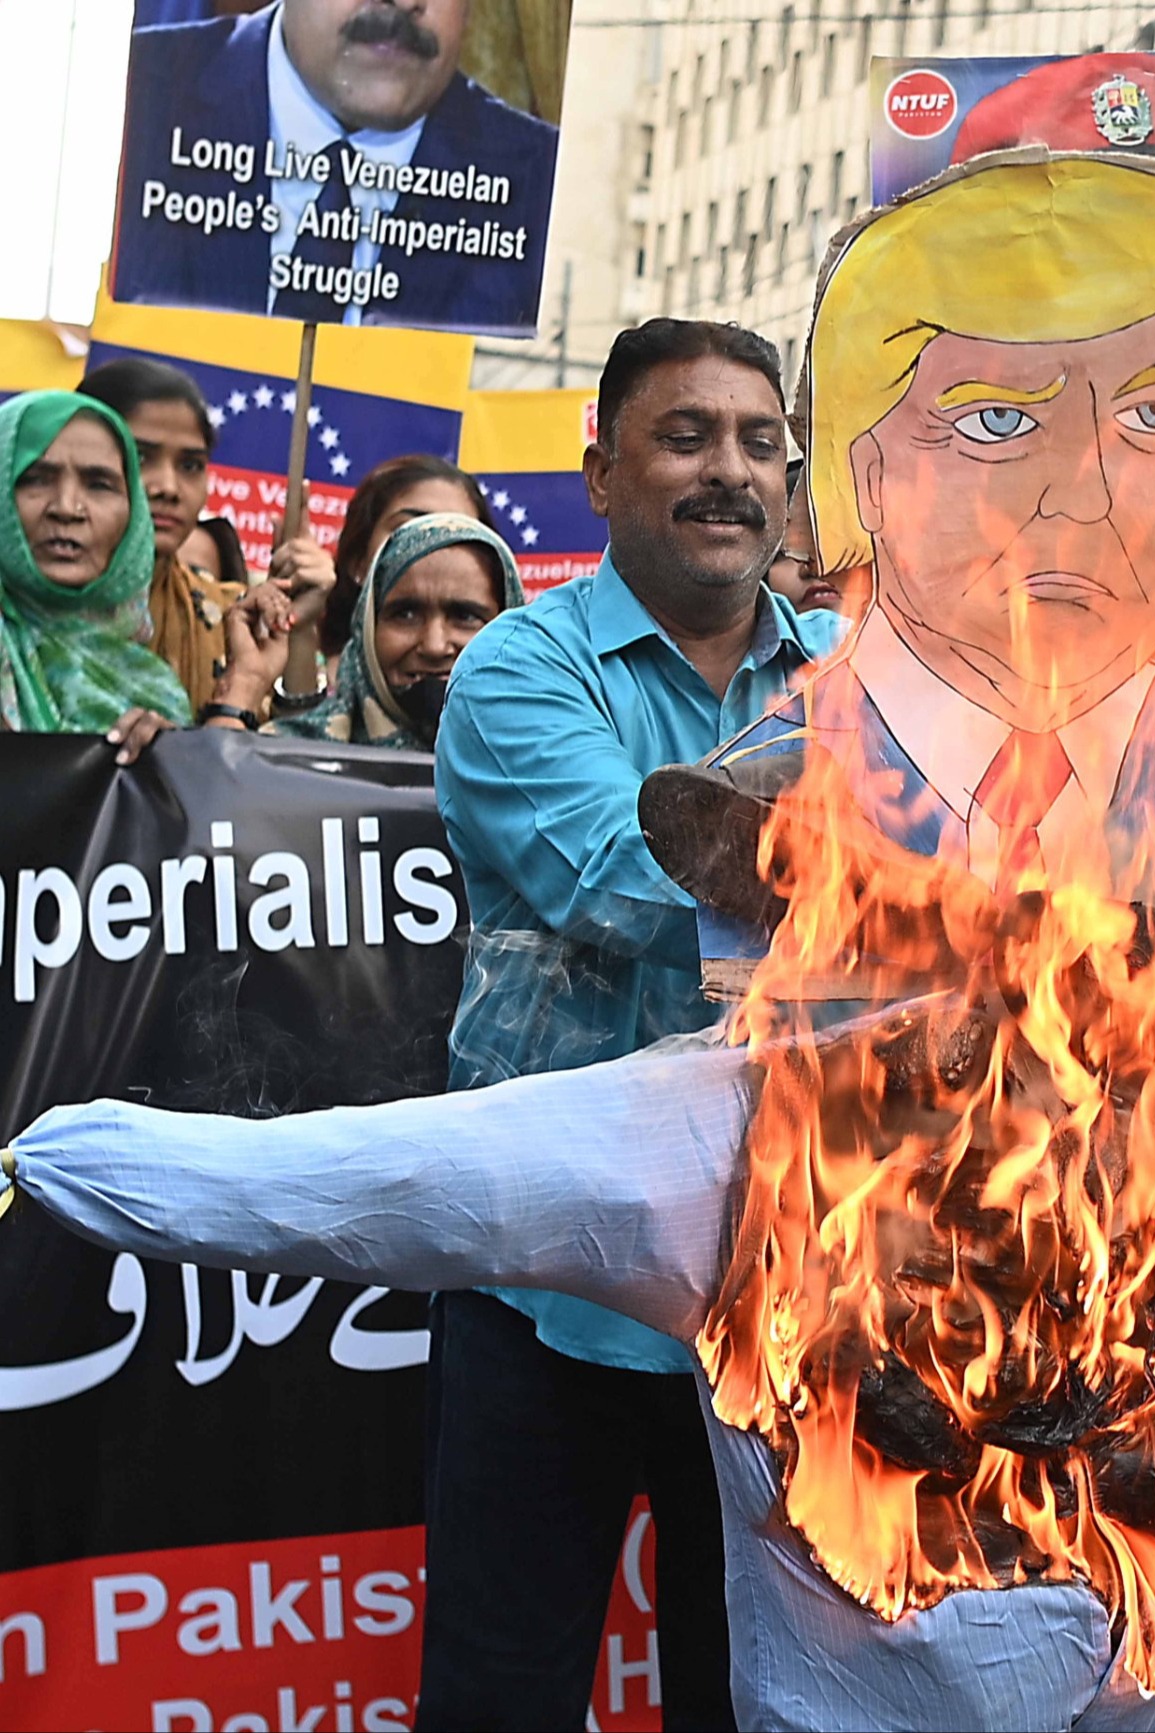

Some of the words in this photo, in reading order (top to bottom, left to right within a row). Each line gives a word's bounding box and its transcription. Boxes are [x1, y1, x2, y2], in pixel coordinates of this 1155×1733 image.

[891, 93, 950, 111] NTUF
[171, 127, 254, 183] Long
[264, 140, 330, 183] Live
[340, 149, 510, 204] Venezuelan
[141, 180, 280, 234] People's
[297, 203, 527, 260] Anti-Imperialist
[270, 254, 399, 305] Struggle
[0, 816, 458, 1002] perialis
[92, 1554, 426, 1665] Pakis
